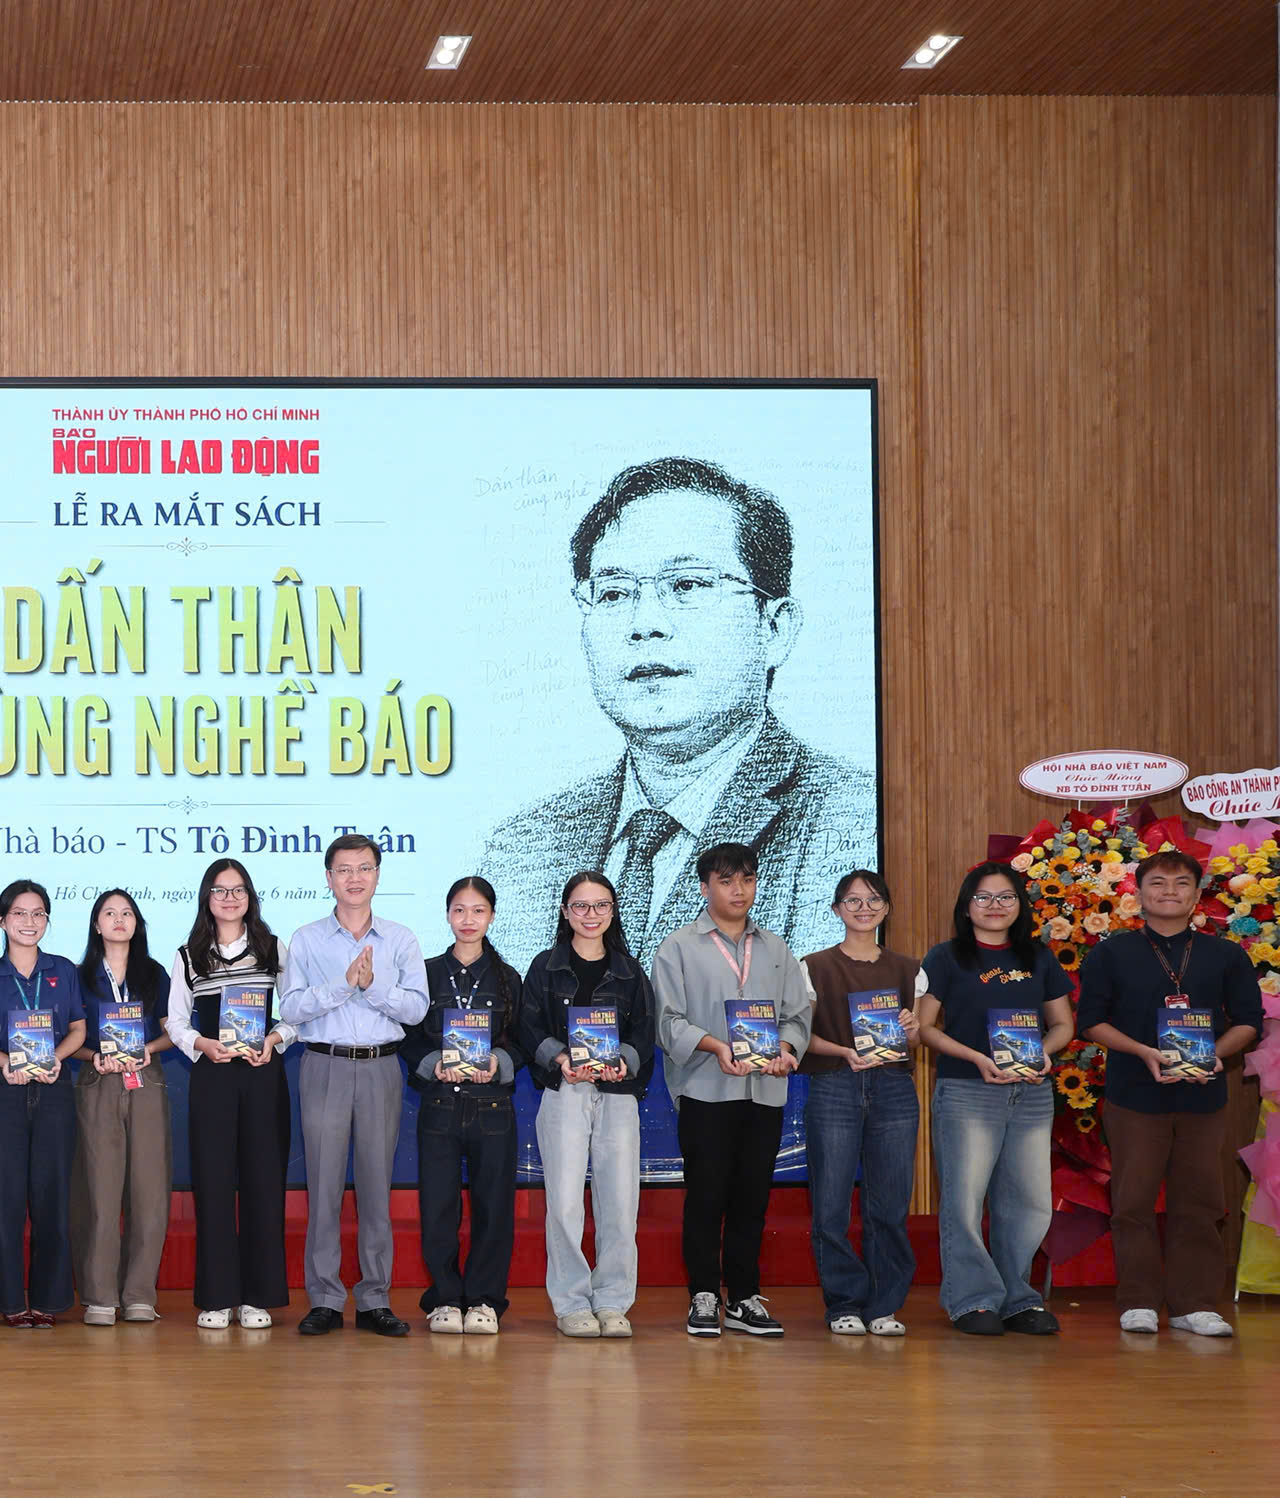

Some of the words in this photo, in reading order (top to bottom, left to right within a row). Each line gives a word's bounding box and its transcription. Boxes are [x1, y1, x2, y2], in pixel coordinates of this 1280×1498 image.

[52, 406, 104, 421] THÀNH
[108, 406, 129, 421] ỦY
[133, 406, 186, 421] THÀNH
[190, 405, 221, 421] PHỐ
[225, 405, 249, 421] HỒ
[252, 406, 279, 421] CHÍ
[281, 408, 320, 421] MINH
[52, 436, 151, 474] NGƯỜI
[161, 440, 222, 474] LAO
[231, 436, 320, 476] ĐỘNG
[53, 492, 89, 526] LỄ
[100, 502, 144, 526] RA
[154, 492, 224, 526] MẮT
[235, 495, 321, 527] SÁCH
[1, 558, 148, 675] DẤN
[169, 566, 363, 675] THÂN
[134, 679, 316, 778] NGHỀ
[327, 679, 454, 778] BÁO
[1042, 762, 1061, 773] HỘI
[1064, 761, 1086, 772] NHÀ
[1090, 761, 1113, 771] BÁO
[1116, 760, 1140, 771] VIỆT
[1143, 762, 1167, 770] NAM
[1056, 785, 1071, 793] NB
[1073, 784, 1088, 793] TÔ
[1090, 783, 1118, 793] ĐÌNH
[1122, 782, 1152, 792] TUÂN
[1187, 785, 1205, 803] BÁO
[1206, 777, 1229, 797] CÔNG
[1231, 779, 1242, 796] AN
[1243, 773, 1272, 793] THÀNH
[1209, 798, 1261, 816] Chúc
[52, 826, 106, 855] báo
[136, 827, 177, 855] TS
[188, 826, 230, 855] Tô
[240, 825, 322, 855] Đình
[333, 825, 417, 854] Tân
[54, 884, 77, 900] Hồ
[82, 885, 110, 901] Ch
[161, 885, 196, 904] ngày
[270, 886, 280, 899] 6
[284, 886, 317, 899] năm
